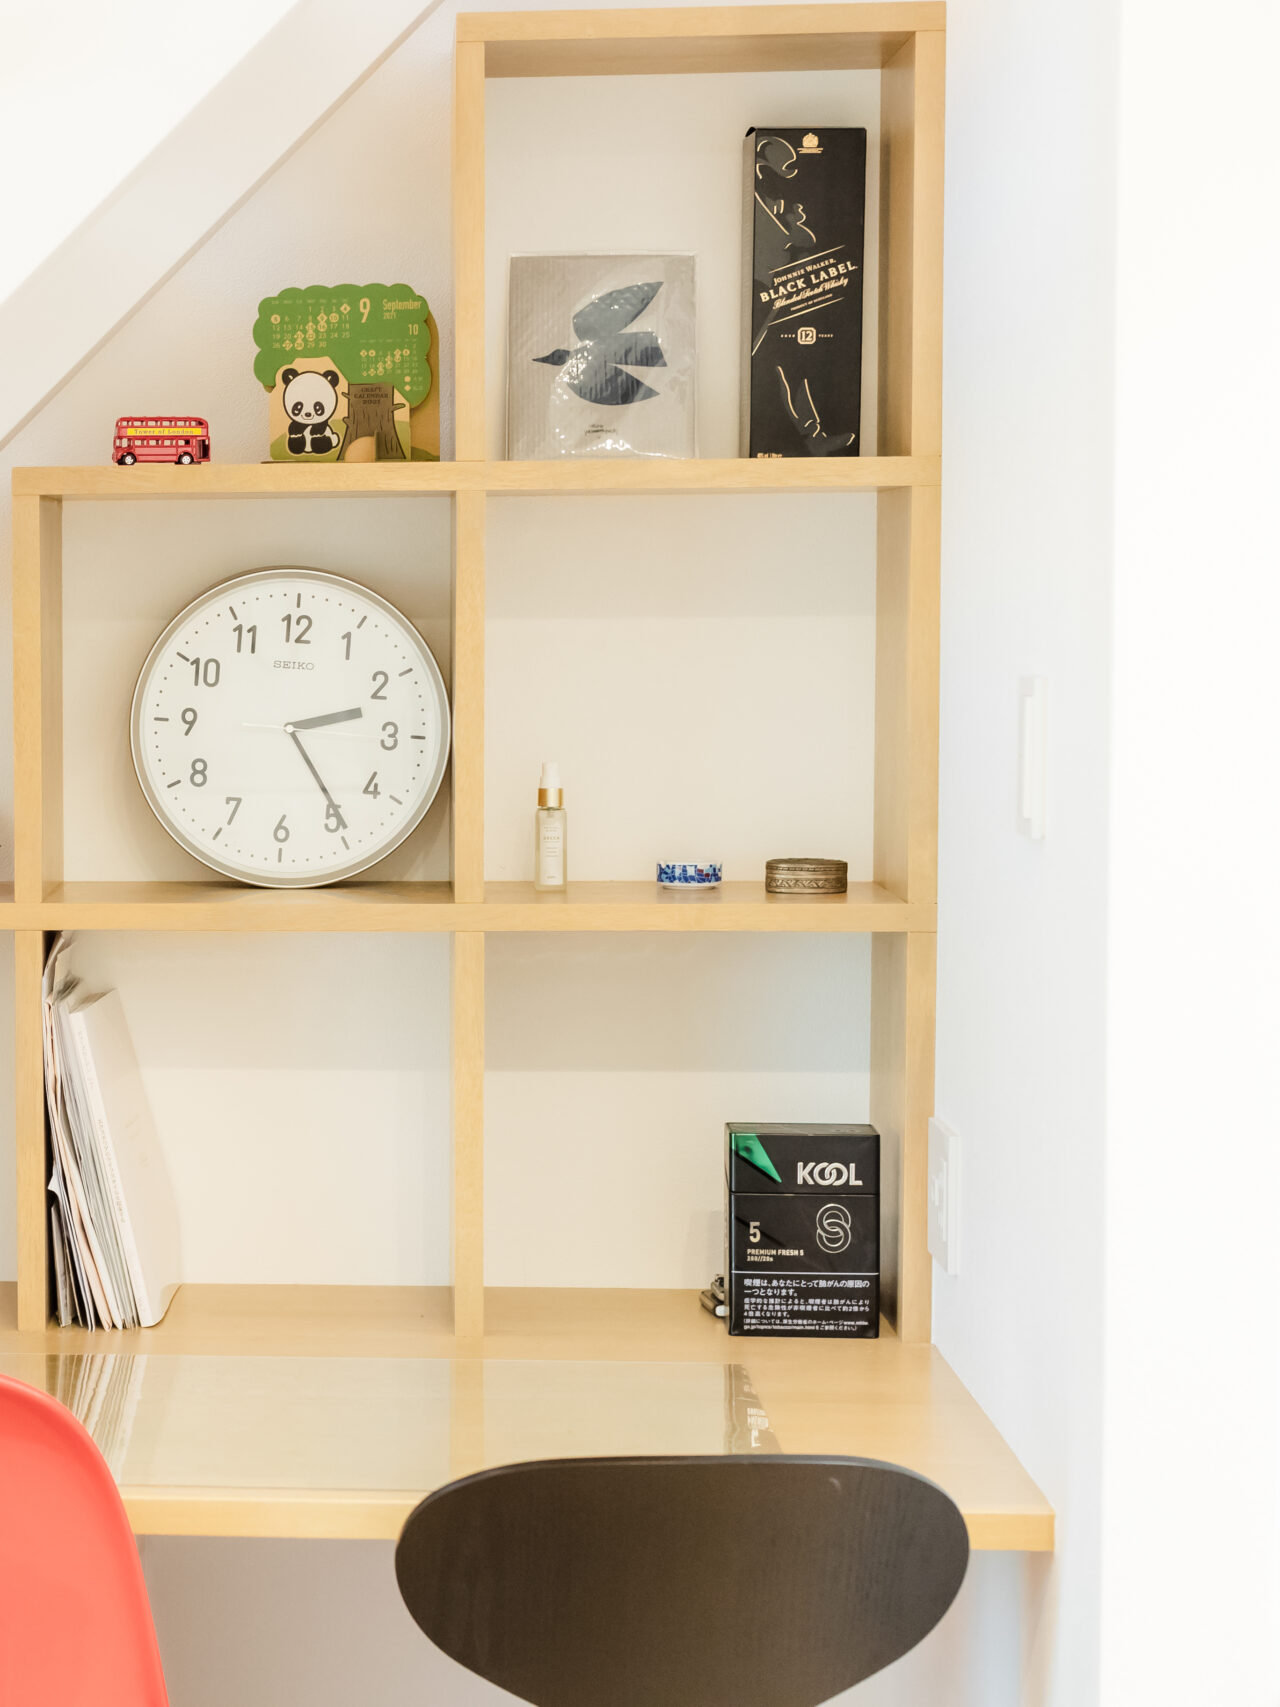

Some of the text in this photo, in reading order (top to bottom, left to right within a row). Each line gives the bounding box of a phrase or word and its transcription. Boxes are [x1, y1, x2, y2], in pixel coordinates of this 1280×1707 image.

[760, 278, 807, 302] BLACK
[773, 269, 805, 286] JOHNNIE
[822, 276, 849, 291] Whisky
[359, 297, 371, 324] 9
[382, 298, 422, 313] September
[407, 323, 419, 336] 10
[801, 330, 813, 341] 12
[232, 623, 258, 654] 11
[281, 613, 313, 645] 12
[341, 631, 352, 661] 1
[190, 657, 221, 688] 10
[273, 660, 315, 671] SEIKO
[370, 670, 389, 700] 2
[180, 707, 198, 736] 9
[380, 721, 399, 751] 3
[189, 758, 208, 787] 8
[362, 771, 381, 799] 4
[225, 796, 242, 826] 7
[323, 804, 342, 834] 5
[273, 814, 290, 843] 6
[797, 1161, 863, 1186] KOOL
[749, 1221, 761, 1243] 5
[746, 1248, 777, 1256] PREMIUM
